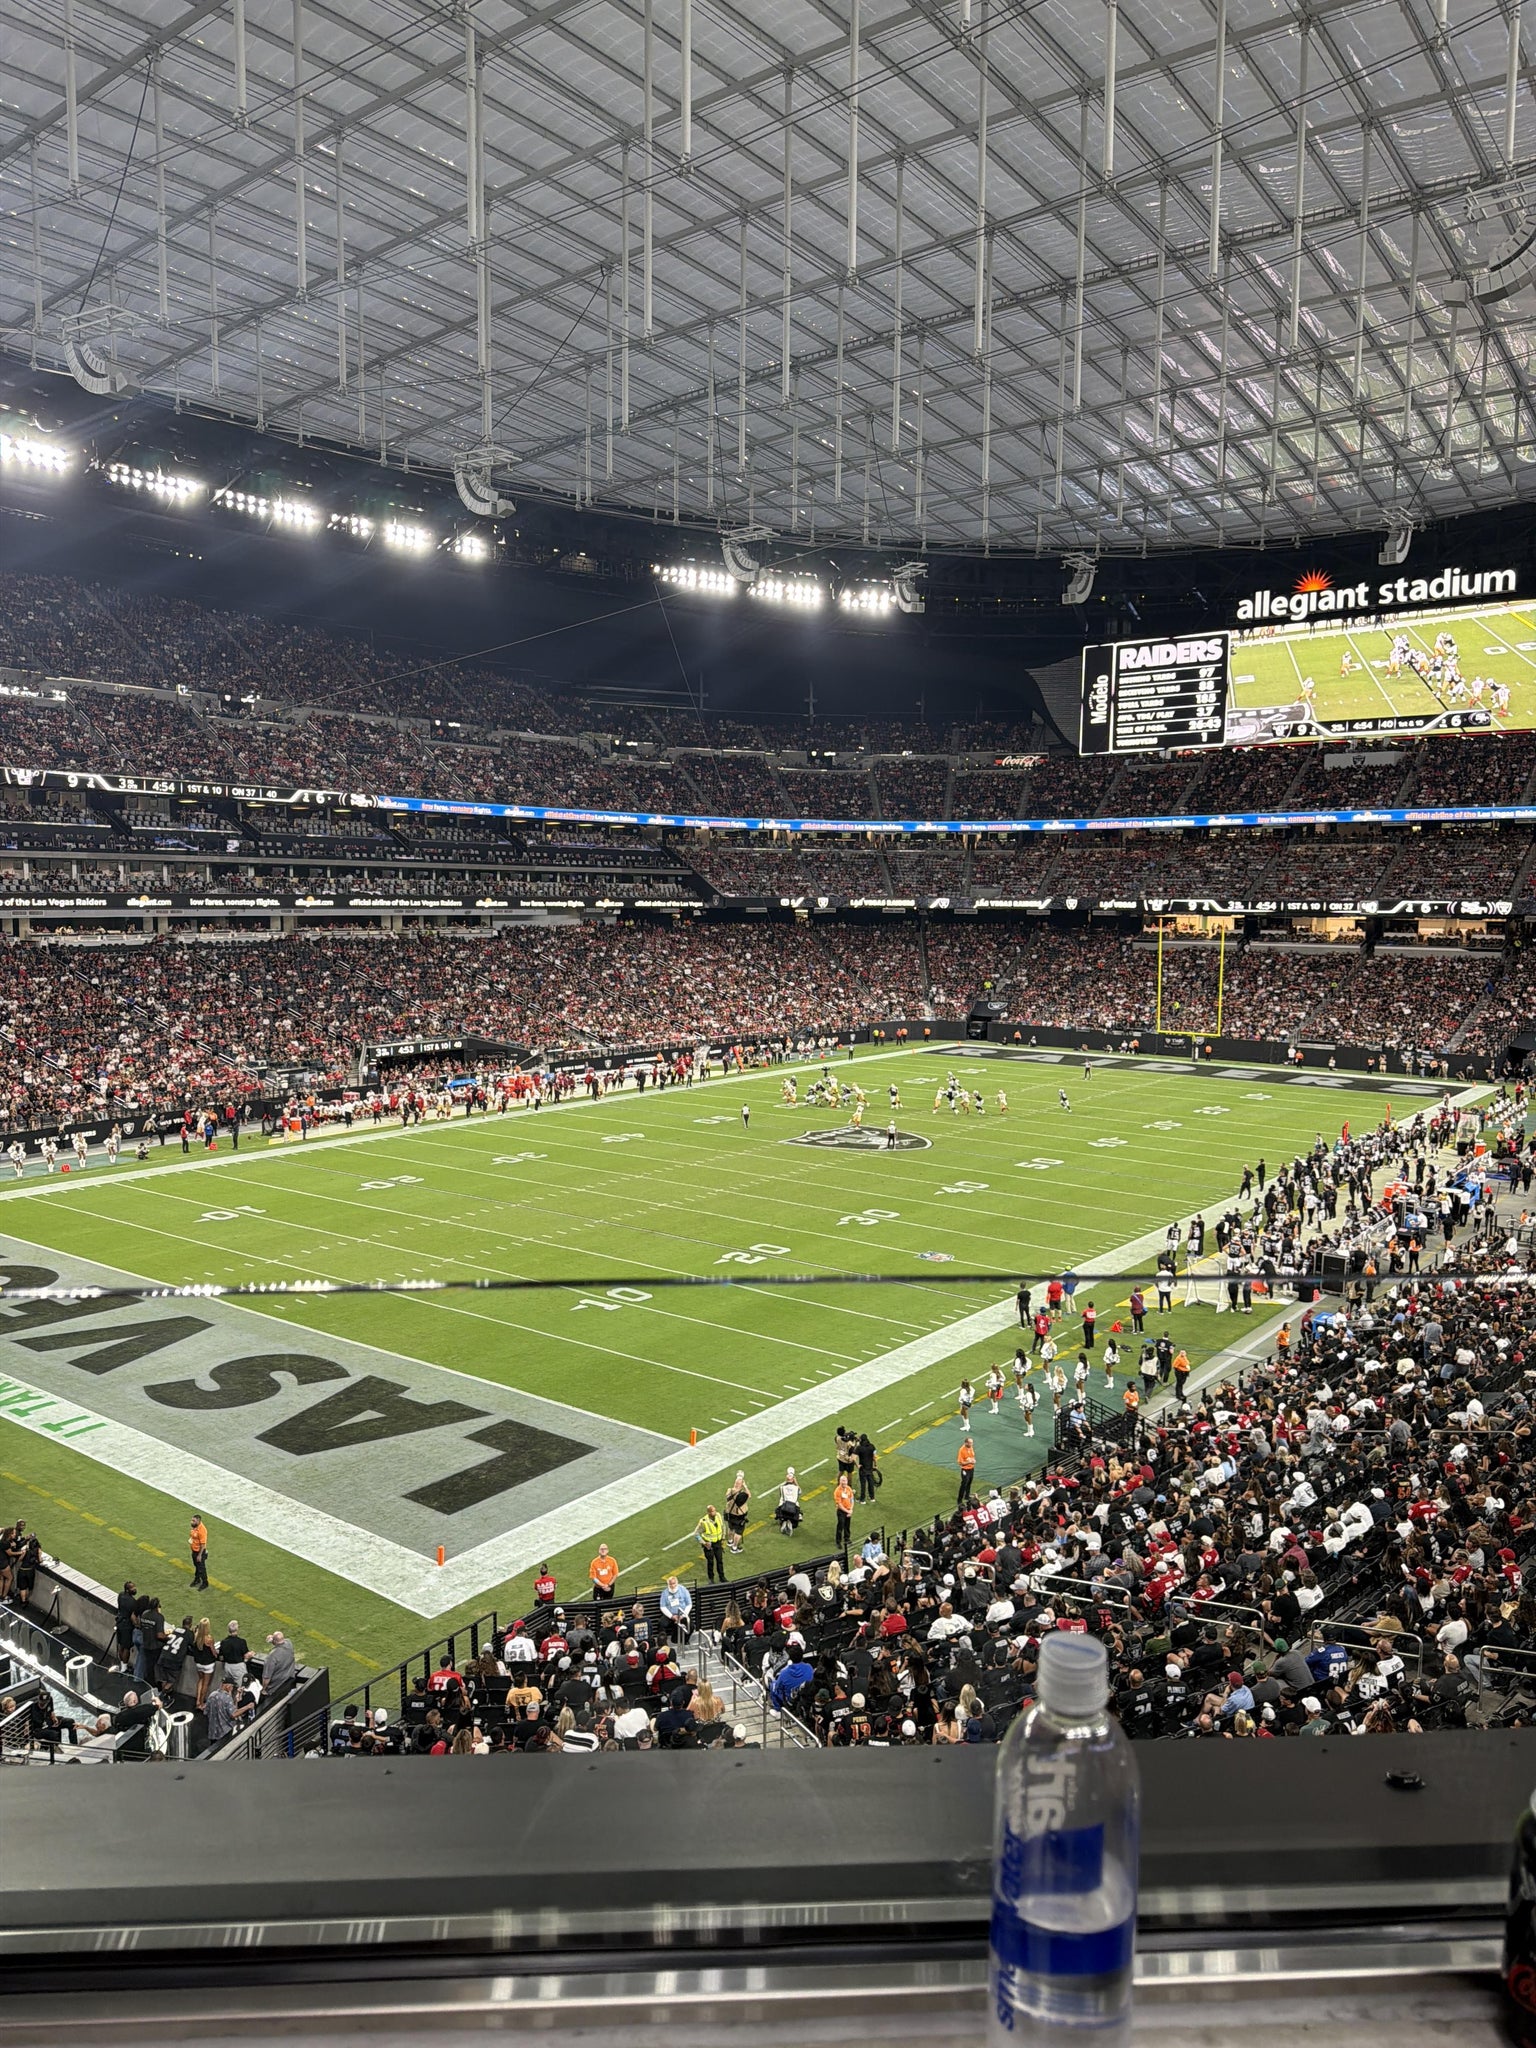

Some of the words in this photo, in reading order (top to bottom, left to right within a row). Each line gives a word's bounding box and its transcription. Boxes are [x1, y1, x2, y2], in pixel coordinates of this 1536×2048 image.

[1236, 582, 1369, 621] allegiant
[1378, 568, 1516, 605] stadium
[1119, 638, 1224, 670] RAIDERS
[1199, 667, 1216, 679] 97
[1090, 674, 1110, 725] Modelo
[1381, 719, 1393, 729] 40
[1450, 715, 1462, 727] 6
[1297, 724, 1307, 736] 9
[67, 774, 79, 788] 9
[118, 778, 127, 790] 3
[151, 781, 175, 792] 4:54
[187, 784, 203, 794] 1ST
[203, 785, 210, 794] &
[211, 785, 223, 795] 10
[231, 787, 245, 796] ON
[245, 788, 256, 797] 37
[266, 790, 277, 799] 40
[315, 793, 325, 804] 6
[31, 898, 47, 906] Las
[48, 899, 75, 908] Vegas
[1188, 901, 1197, 911] 9
[1310, 902, 1321, 910] 10
[1420, 902, 1431, 913] 6
[938, 1047, 1449, 1096] RAIDERS
[1014, 1157, 1065, 1170] 50
[939, 1180, 990, 1195] 40
[841, 1208, 901, 1226] 30
[719, 1243, 792, 1265] 20
[577, 1286, 654, 1312] 10
[143, 1352, 600, 1516] LAS
[976, 1511, 989, 1525] 97
[1358, 1683, 1381, 1700] 98
